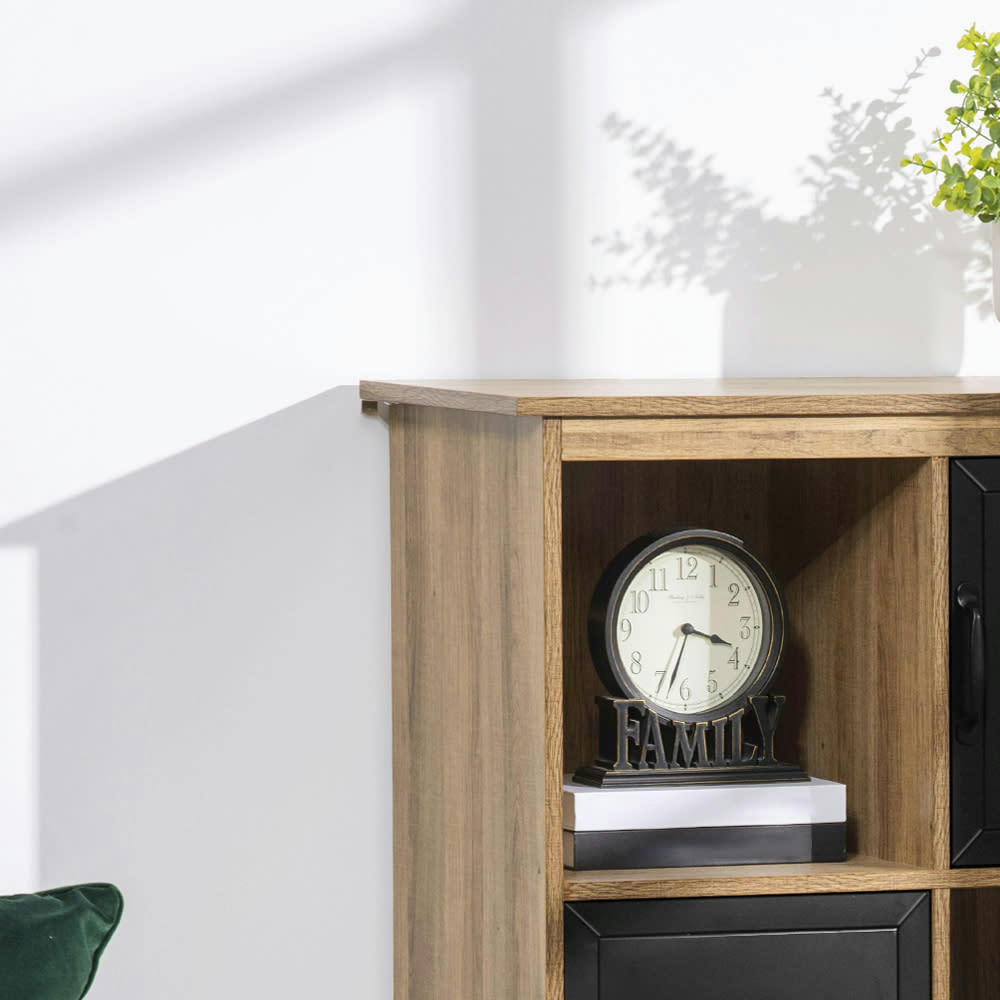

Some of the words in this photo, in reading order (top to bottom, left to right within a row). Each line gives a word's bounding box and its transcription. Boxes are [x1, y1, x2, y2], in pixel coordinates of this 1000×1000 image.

[649, 567, 668, 591] 11
[676, 556, 698, 580] 12
[709, 564, 718, 588] 1
[630, 589, 650, 614] 10
[728, 582, 740, 606] 2
[621, 618, 632, 642] 9
[739, 616, 751, 640] 3
[630, 650, 642, 674] 8
[727, 646, 739, 670] 4
[655, 670, 667, 693] 7
[679, 676, 690, 700] 6
[708, 669, 718, 693] 5
[613, 696, 785, 770] FAMILY
